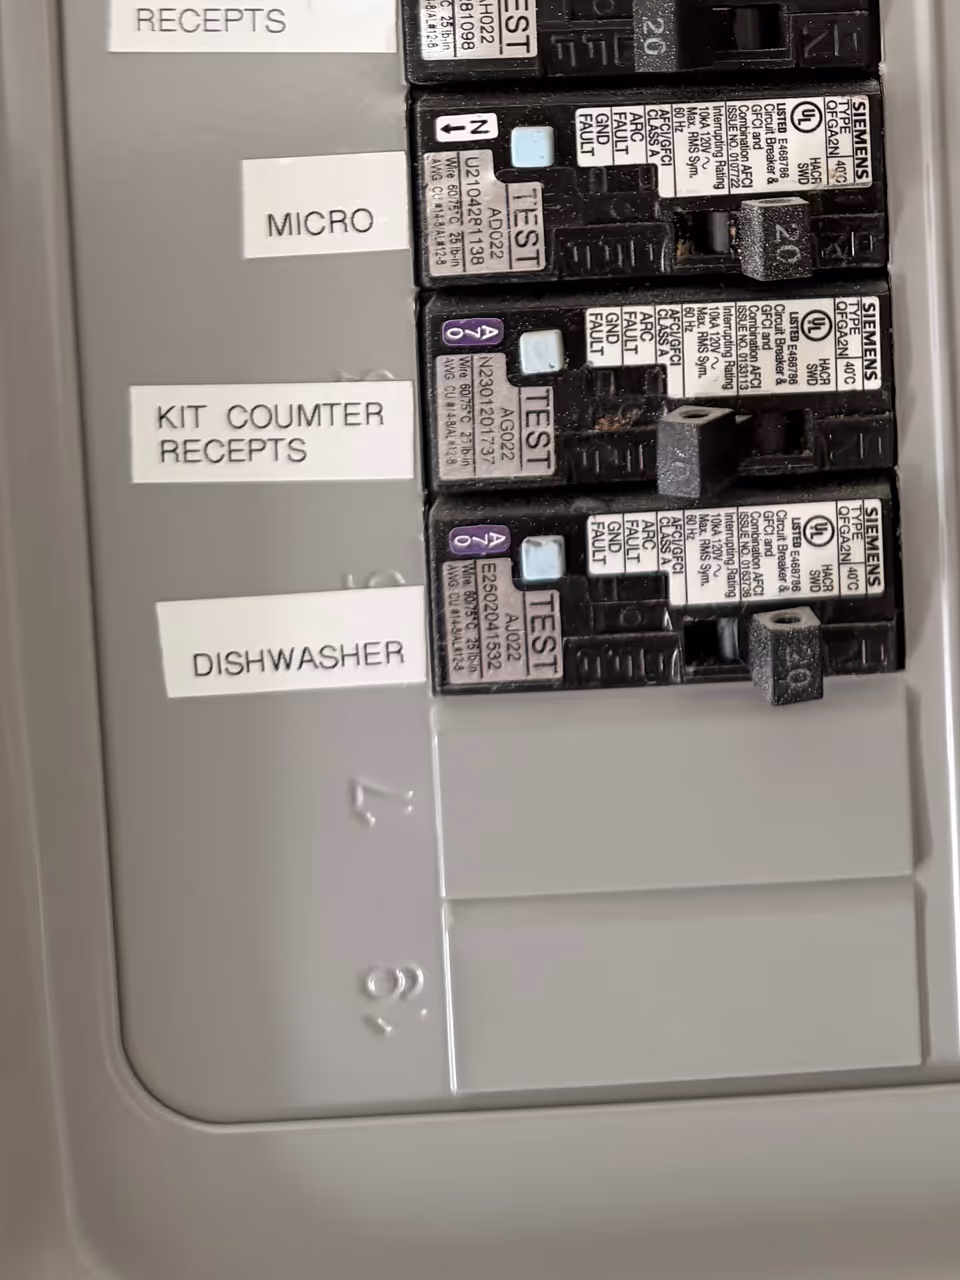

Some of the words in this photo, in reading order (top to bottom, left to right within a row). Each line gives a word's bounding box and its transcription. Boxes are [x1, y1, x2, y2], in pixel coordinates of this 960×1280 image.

[136, 8, 286, 33] RECEPTS
[853, 101, 869, 179] SIEMENS
[267, 208, 374, 237] MICRO
[488, 207, 504, 259] AD022
[513, 188, 540, 265] TEST
[775, 224, 800, 262] 20
[863, 302, 877, 381] SIEMENS
[157, 404, 207, 429] KIT
[226, 402, 384, 429] COUMTER
[500, 407, 514, 460] AG022
[526, 388, 551, 468] TEST
[160, 437, 307, 463] RECEPTS
[865, 507, 880, 587] SIEMENS
[193, 640, 405, 677] DISHWASHER
[505, 613, 521, 661] AJ022
[530, 593, 557, 673] TEST
